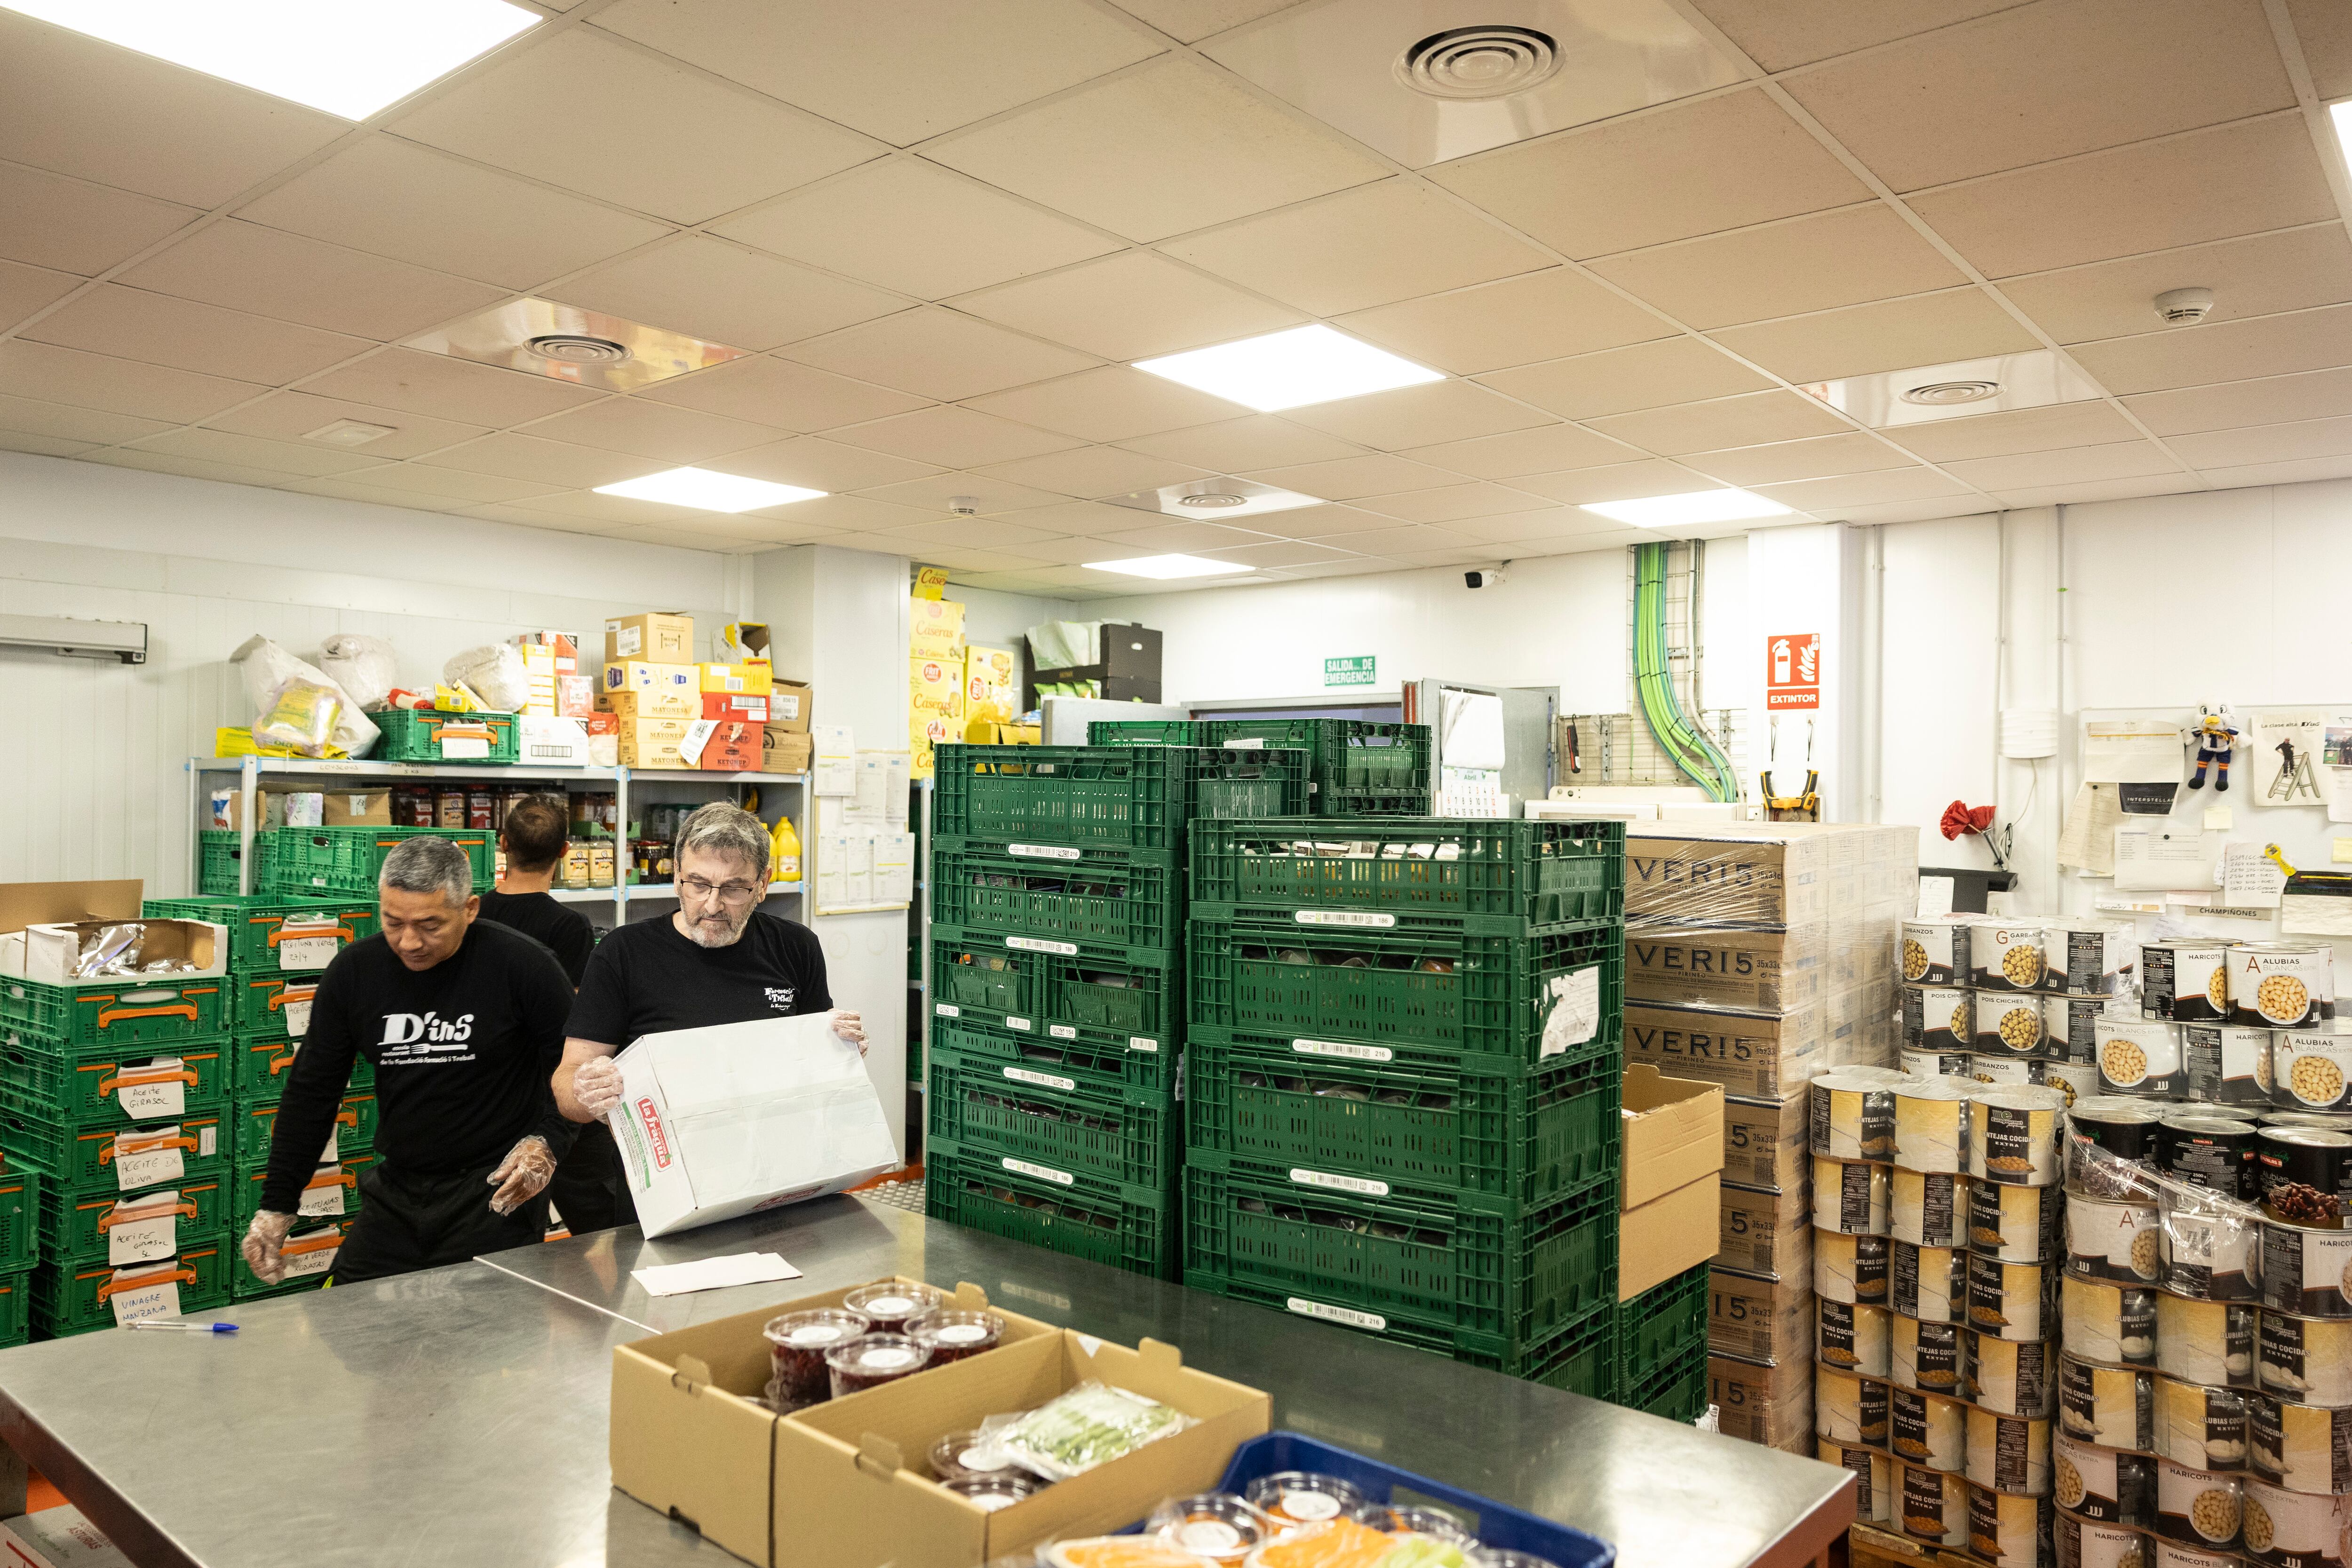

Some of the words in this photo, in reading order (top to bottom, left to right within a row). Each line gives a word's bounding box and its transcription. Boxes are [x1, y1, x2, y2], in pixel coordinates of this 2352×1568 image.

[916, 621, 953, 638] Caseras
[925, 667, 939, 676] FRIT
[1327, 660, 1353, 672] SALIDA
[1362, 658, 1373, 670] DE
[1325, 670, 1375, 684] EMERGENCIA
[971, 680, 980, 700] FRIT
[914, 693, 952, 710] Caseras
[1771, 694, 1817, 703] EXTINTOR
[1633, 859, 1729, 886] VERI
[1734, 863, 1754, 887] 5
[2200, 906, 2257, 917] CHAMPIÑONES
[1996, 931, 2008, 945] G
[1633, 944, 1729, 974] VERI
[1734, 950, 1754, 976] 5
[2246, 956, 2261, 974] A
[1798, 1009, 1815, 1027] VERI
[1632, 1027, 1727, 1059] VERI
[1733, 1038, 1752, 1062] 5
[2281, 1035, 2294, 1053] A
[2296, 1045, 2338, 1053] BLANCAS
[1973, 1060, 2010, 1070] GARBANZOS
[1731, 1124, 1749, 1148] 5
[1981, 1130, 2008, 1141] LENTEJAS
[2263, 1170, 2289, 1183] Alubias
[1974, 1211, 1991, 1220] EXTRA
[1982, 1206, 2007, 1217] COCIDAS
[1730, 1210, 1748, 1234] 5
[2119, 1210, 2135, 1228] A
[1973, 1290, 1993, 1299] EXTRA
[1984, 1285, 2010, 1297] COCIDAS
[121, 1293, 162, 1309] VINAGRE
[122, 1304, 167, 1321] MANZANA
[1729, 1296, 1748, 1321] 5
[1823, 1309, 1848, 1320] Eurogourmet
[1826, 1332, 1845, 1340] EXTRA
[1836, 1327, 1861, 1337] COCIDAS
[1911, 1344, 1939, 1355] LENTEJAS
[2267, 1349, 2293, 1361] EXTRA
[2279, 1344, 2312, 1357] COCIDAS
[1727, 1381, 1746, 1406] 5
[2065, 1393, 2084, 1405] EXTRA
[2073, 1389, 2100, 1403] COCIDAS
[1898, 1422, 1917, 1432] EXTRA
[1908, 1417, 1934, 1429] COCIDAS
[2200, 1416, 2226, 1425] ALUBIAS
[2262, 1425, 2289, 1440] COCIDAS
[2170, 1468, 2212, 1482] HARICOTS
[1907, 1476, 1937, 1488] Eurogourmet
[1911, 1500, 1934, 1510] EXTRA
[1923, 1496, 1950, 1506] COCIDAS
[2332, 1497, 2343, 1517] A
[1980, 1513, 2005, 1528] COCIDAS
[2095, 1532, 2133, 1542] HARICOTS
[2168, 1552, 2210, 1567] HARICOTS
